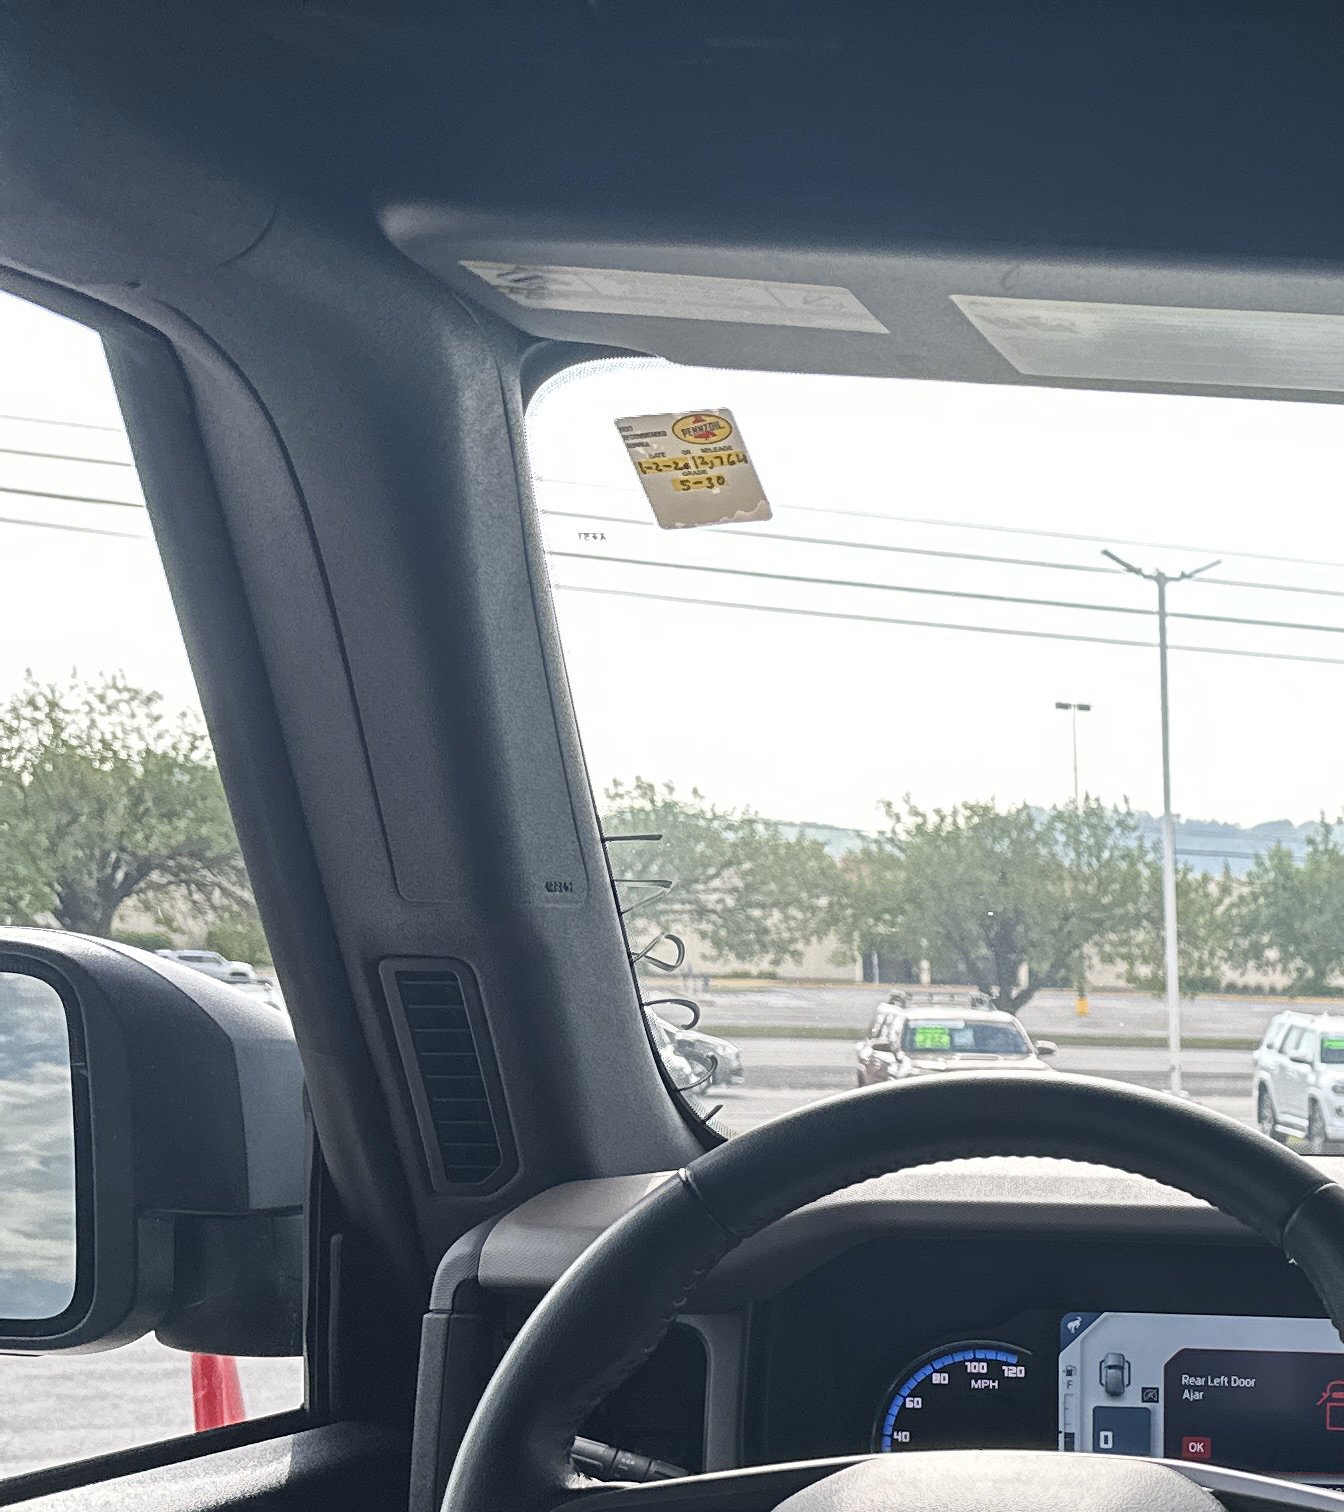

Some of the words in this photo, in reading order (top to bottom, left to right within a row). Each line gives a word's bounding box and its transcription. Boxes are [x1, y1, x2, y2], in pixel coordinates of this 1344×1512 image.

[681, 421, 725, 438] PENNZOIL
[965, 1362, 988, 1374] 100
[1001, 1365, 1026, 1378] 120
[932, 1372, 949, 1385] 80
[970, 1379, 999, 1389] MPH
[1067, 1380, 1073, 1389] F
[1181, 1374, 1206, 1386] Rear
[1208, 1375, 1229, 1387] Left
[1231, 1376, 1256, 1387] Door
[1182, 1389, 1204, 1401] Ajar
[905, 1397, 922, 1409] 60
[893, 1431, 910, 1443] 40
[1100, 1431, 1113, 1449] 0
[1188, 1441, 1205, 1453] OK
